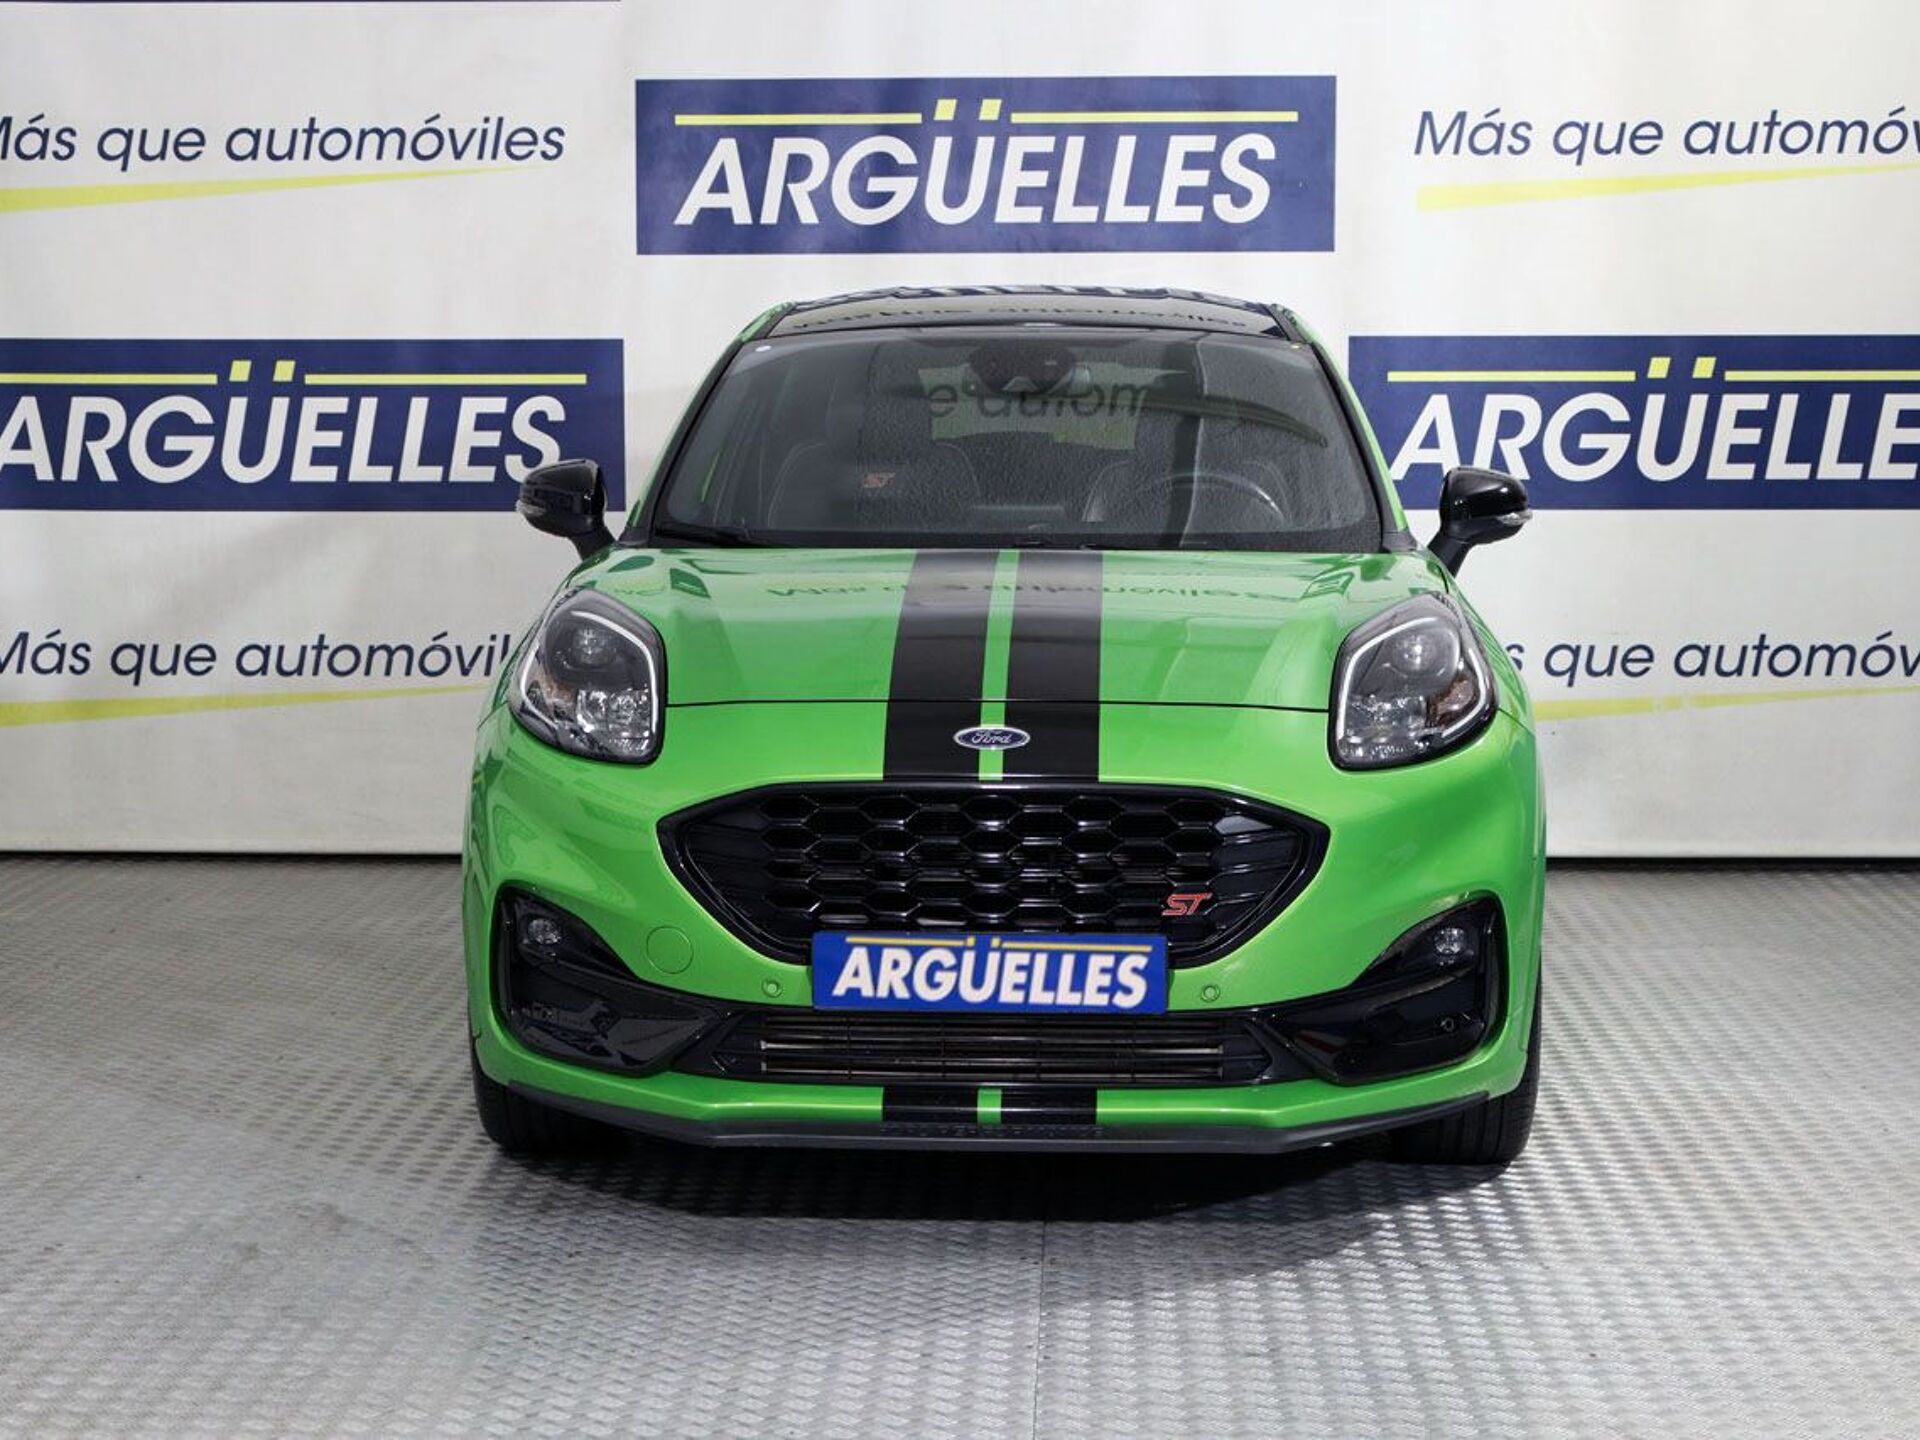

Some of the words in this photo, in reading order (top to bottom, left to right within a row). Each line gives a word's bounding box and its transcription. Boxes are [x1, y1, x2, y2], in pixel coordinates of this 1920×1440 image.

[97, 127, 206, 172] que
[225, 113, 565, 162] automóviles
[674, 98, 1277, 226] ARGÜELLES
[1415, 108, 1532, 156] Más
[1553, 121, 1663, 166] que
[0, 360, 566, 484] ARGÜELLES
[109, 642, 217, 687] que
[1544, 644, 1655, 688] que
[1673, 630, 1920, 678] automóv
[971, 729, 1013, 744] Ford
[1161, 892, 1213, 916] ST
[832, 936, 1151, 1009] ARGÜELLES
